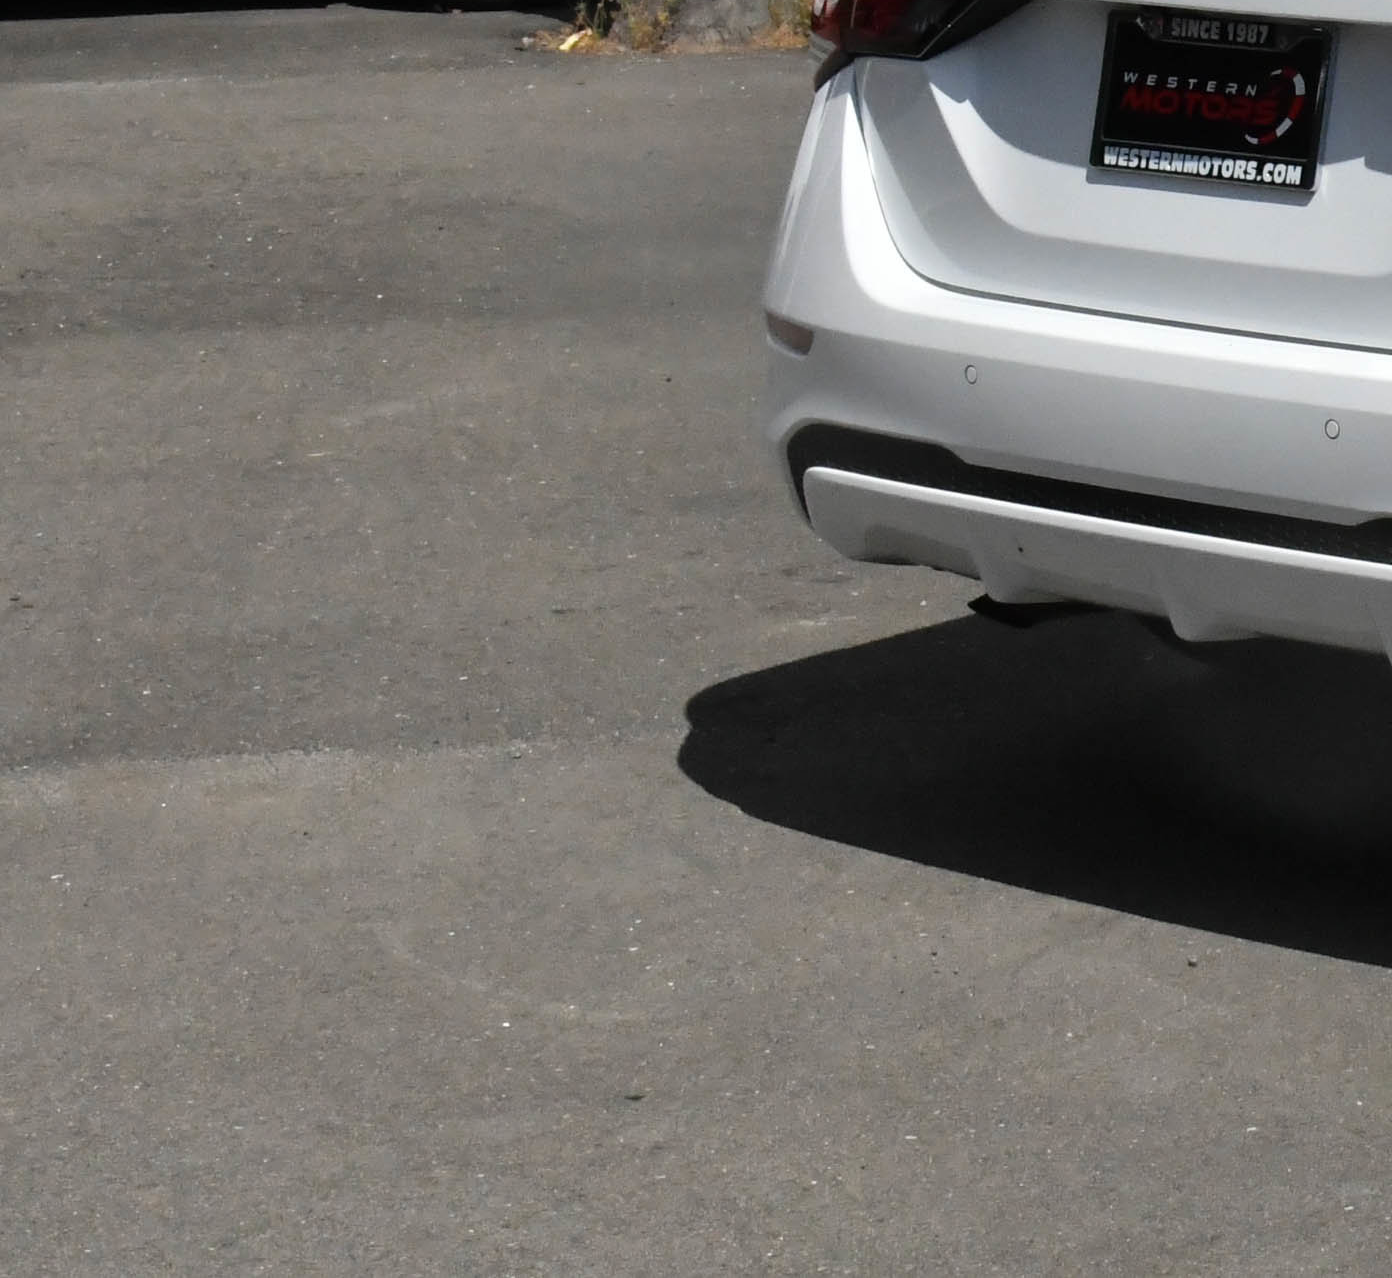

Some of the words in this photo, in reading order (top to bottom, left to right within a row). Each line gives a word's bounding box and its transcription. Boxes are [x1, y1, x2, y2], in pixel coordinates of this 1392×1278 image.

[1171, 17, 1221, 40] SINCE
[1226, 23, 1270, 44] 1987
[1123, 72, 1258, 97] WESTERN
[1120, 85, 1280, 126] MOTORS
[1103, 146, 1302, 185] WESTERNMOTORS.COM
